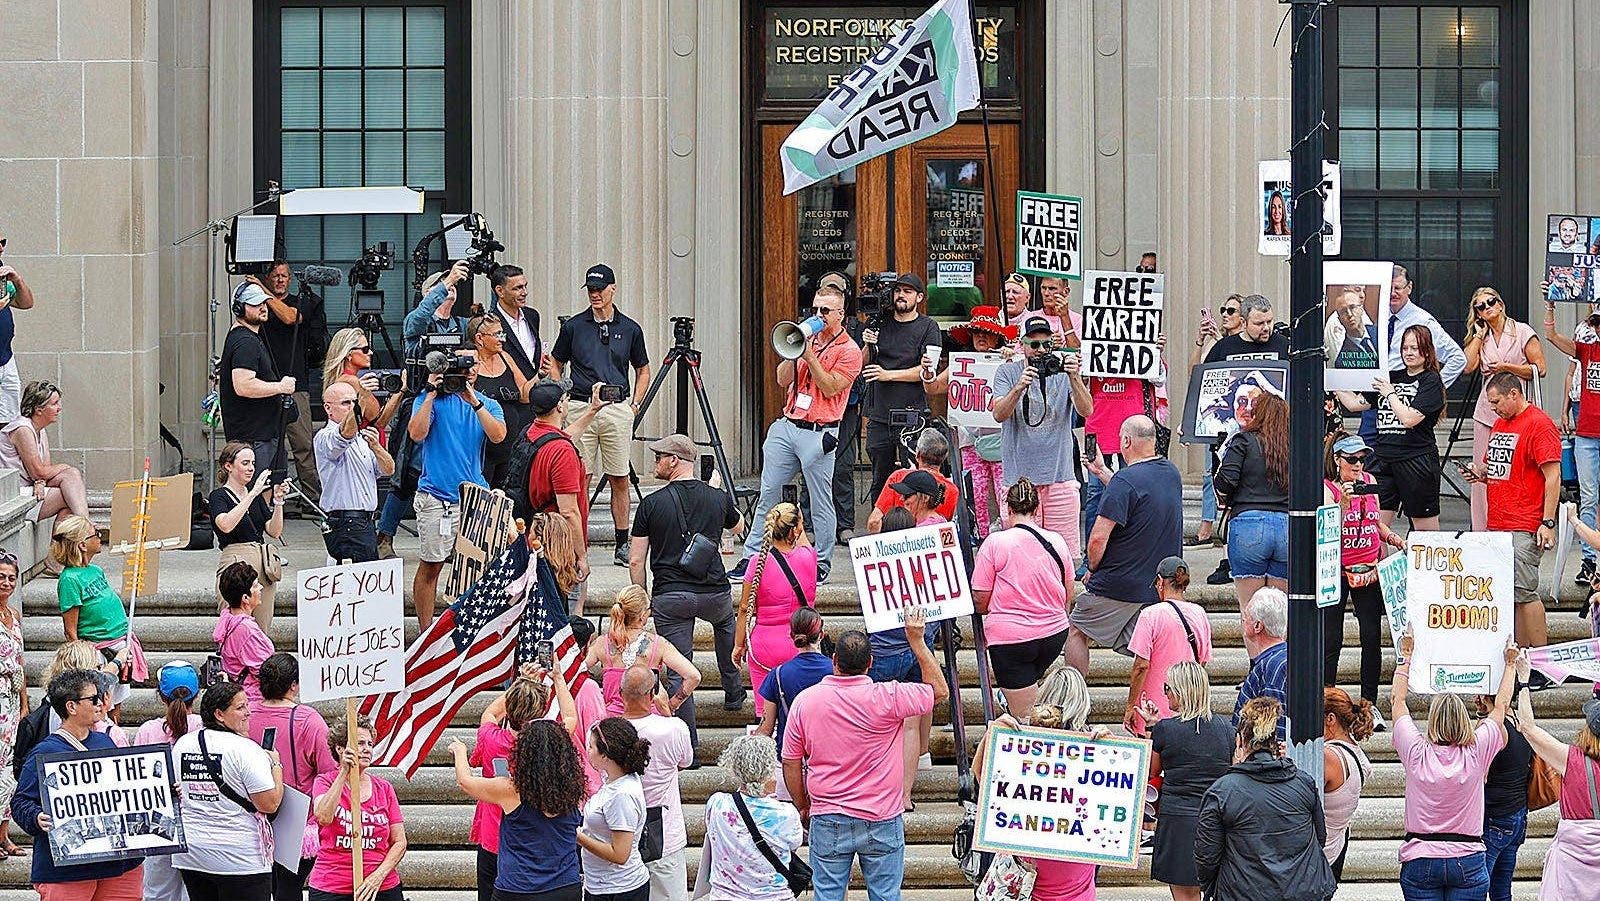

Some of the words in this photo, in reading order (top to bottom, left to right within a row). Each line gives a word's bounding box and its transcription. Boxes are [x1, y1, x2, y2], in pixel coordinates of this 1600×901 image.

[775, 18, 896, 36] NORFOLK
[1275, 181, 1292, 191] JUS
[805, 210, 849, 218] REGISTER
[821, 220, 833, 228] OF
[1021, 199, 1079, 229] FREE
[813, 229, 842, 237] DEEDS
[940, 229, 970, 237] DEEDS
[1021, 227, 1078, 252] KAREN
[802, 243, 843, 251] WILLIAM
[802, 252, 852, 260] O'DONNELL
[930, 252, 980, 260] O'DONNELL
[939, 263, 972, 272] NOTICE
[1027, 249, 1072, 272] READ
[1093, 277, 1155, 307] FREE
[1085, 308, 1160, 342] KAREN
[953, 357, 976, 377] I
[1089, 344, 1155, 375] READ
[1203, 378, 1230, 387] KAREN
[1206, 370, 1228, 378] FREE
[1102, 382, 1125, 393] Quit!
[1488, 463, 1506, 477] EAD
[1318, 514, 1324, 536] 2
[854, 545, 871, 559] JAN
[875, 534, 936, 558] Massachusetts
[941, 531, 953, 546] 22
[1344, 537, 1372, 548] 2024
[1412, 545, 1463, 571] TICK
[304, 572, 343, 602] SEE
[350, 569, 395, 597] YOU
[864, 550, 961, 613] FRAMED
[1440, 575, 1493, 601] TICK
[328, 600, 366, 627] AT
[1428, 604, 1498, 632] BOOM!
[301, 637, 356, 661] UNCLE
[362, 627, 401, 654] JOE'S
[321, 659, 388, 693] HOUSE
[1446, 672, 1486, 683] Turtleboy
[1002, 737, 1095, 763] JUSTICE
[58, 760, 102, 786] STOP
[113, 757, 147, 782] THE
[1022, 760, 1067, 779] FOR
[1078, 769, 1134, 789] JOHN
[53, 785, 167, 820] CORRUPTION
[996, 781, 1074, 804] KAREN
[995, 811, 1084, 836] SANDRA
[335, 836, 353, 849] FO
